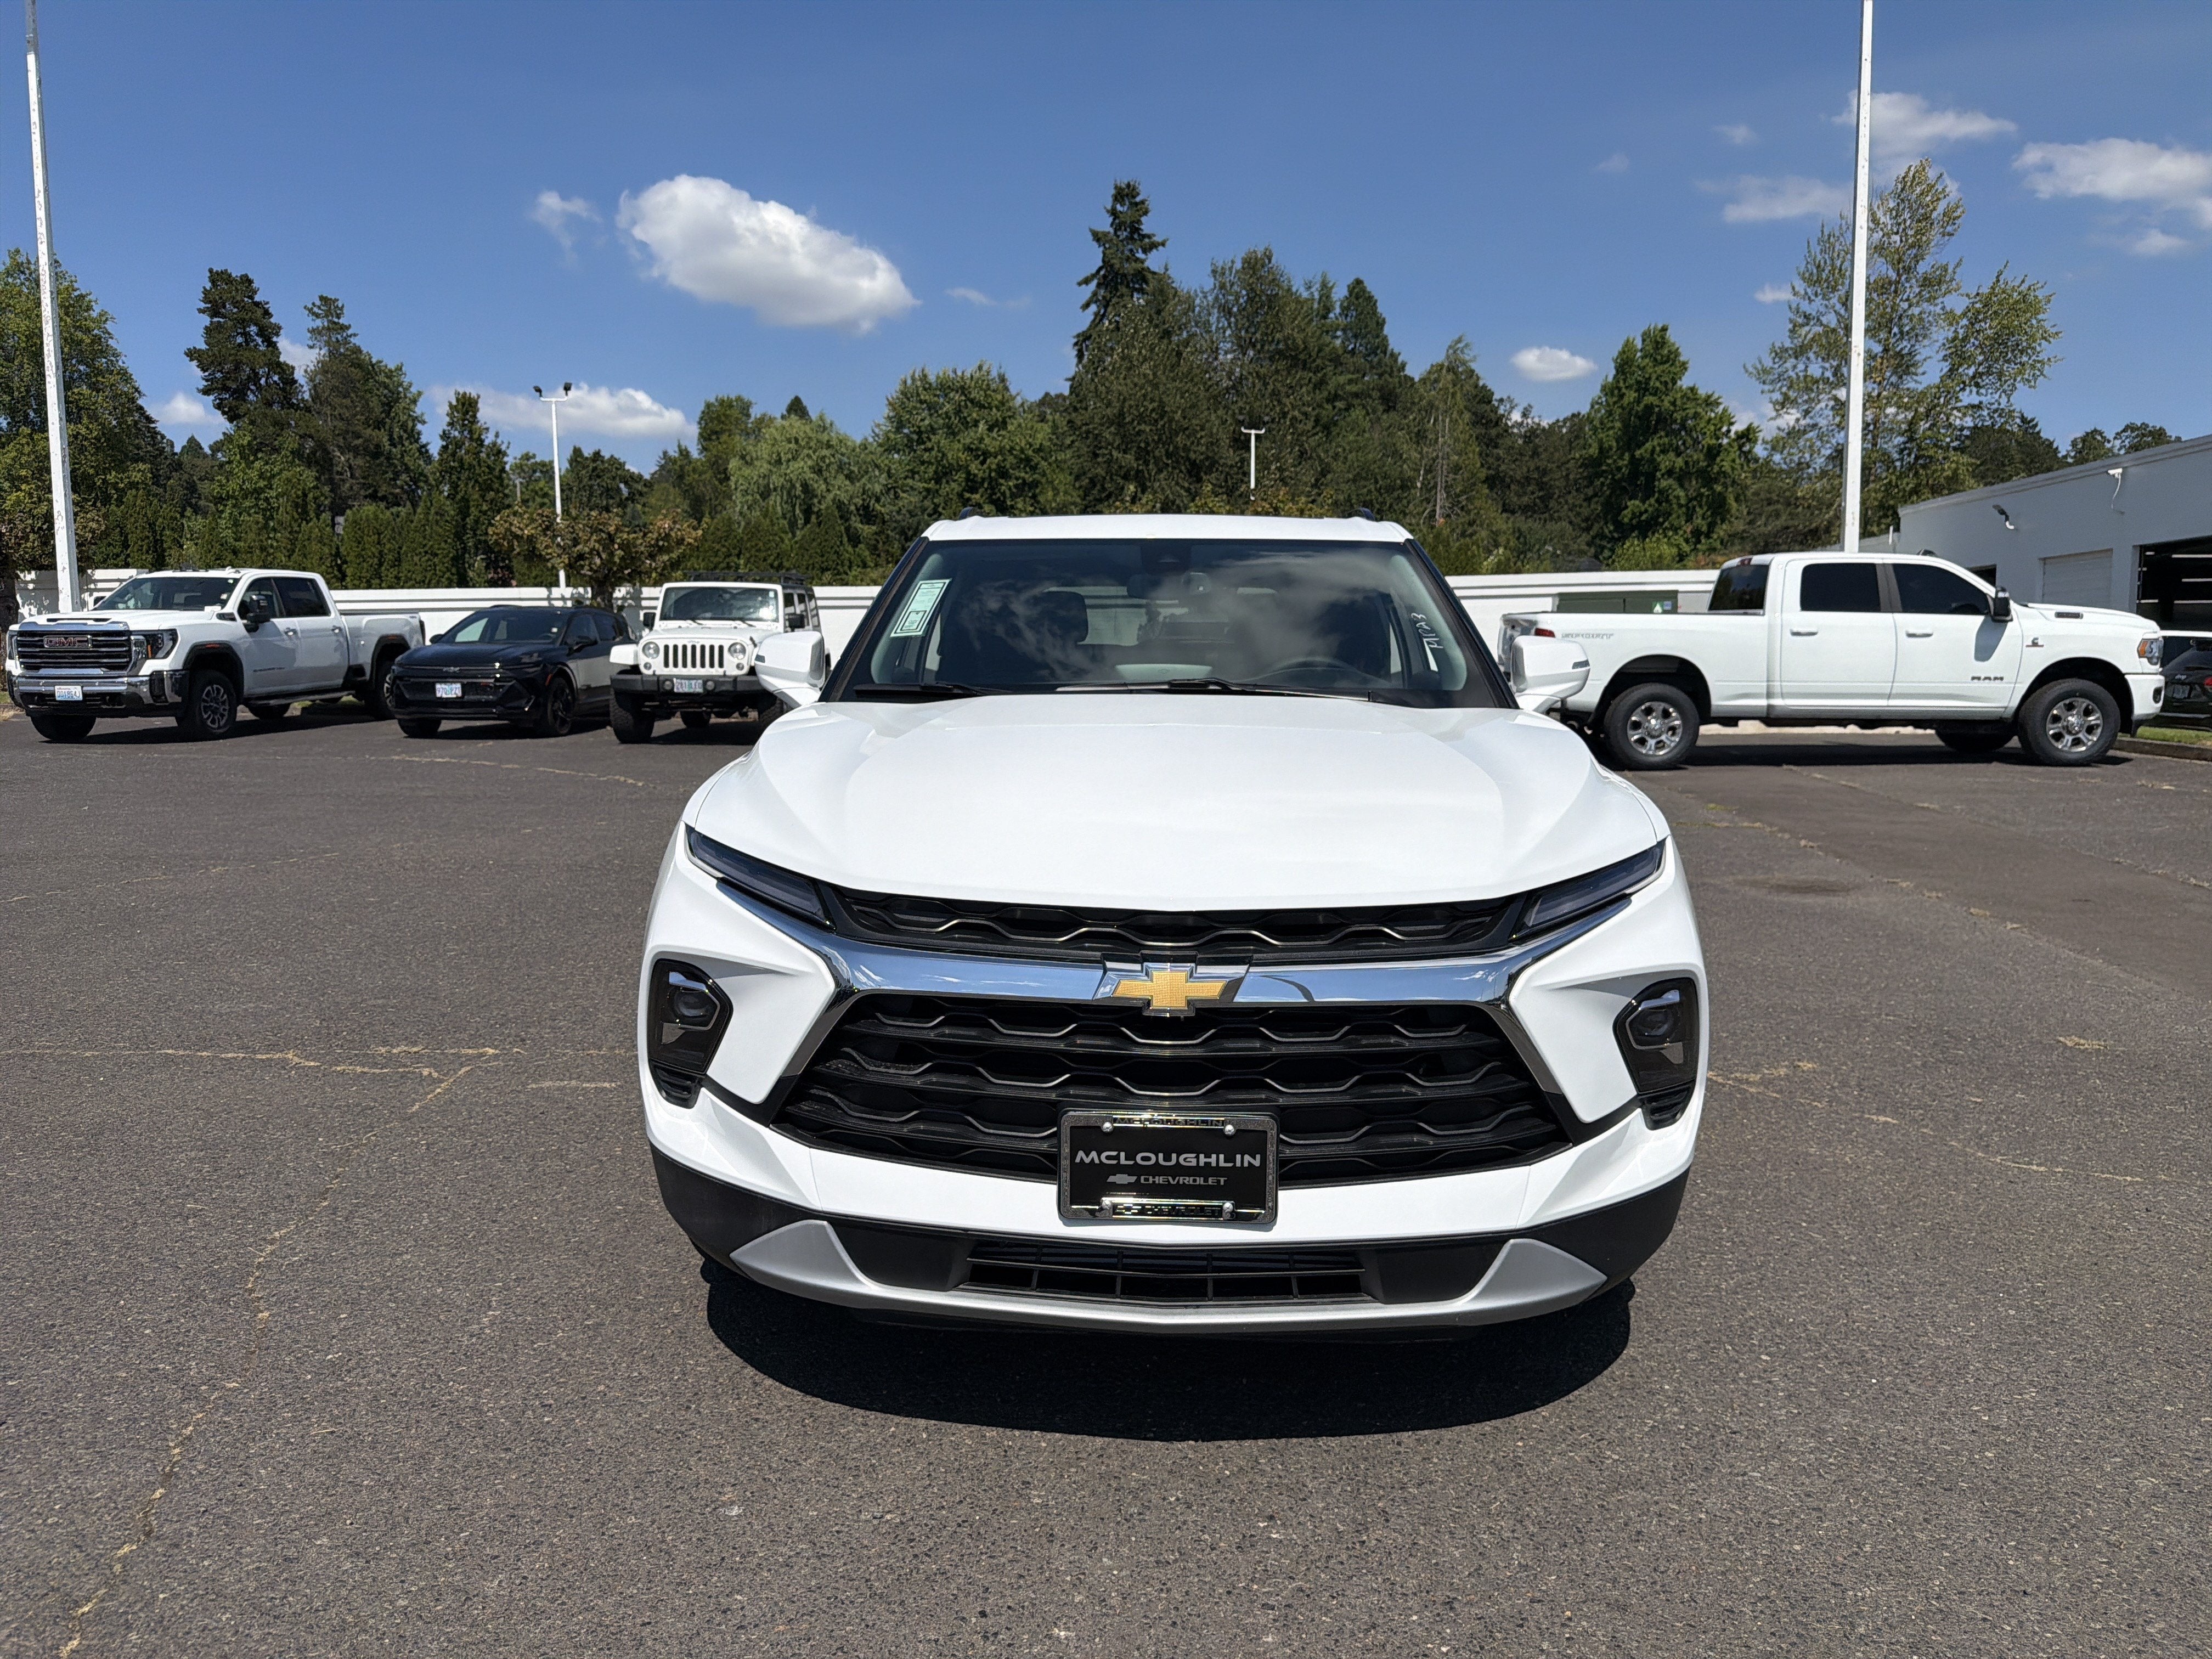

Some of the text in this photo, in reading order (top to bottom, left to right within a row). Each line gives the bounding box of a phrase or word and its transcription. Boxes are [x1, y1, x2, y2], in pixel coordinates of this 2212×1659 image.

[45, 637, 88, 647] GMC
[1074, 1150, 1261, 1167] MCLOUGHLIN
[1140, 1175, 1228, 1186] CHEVROLET
